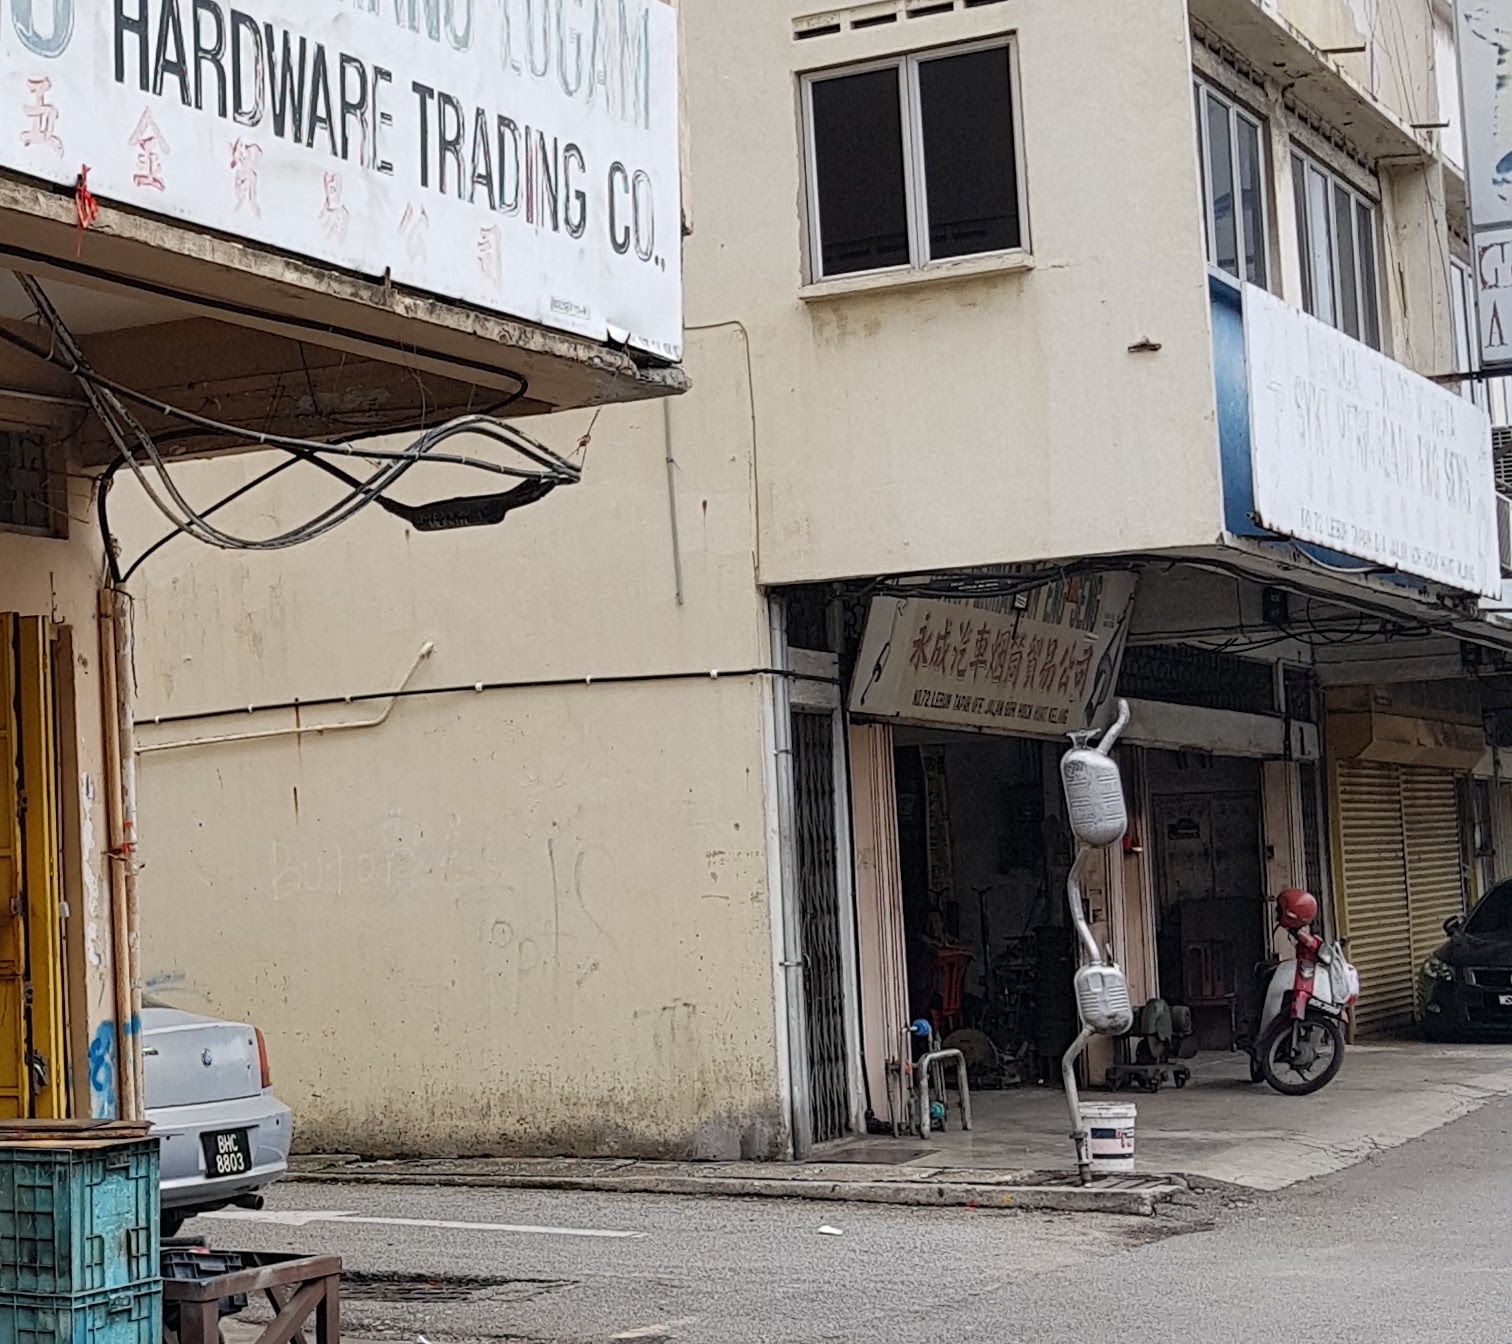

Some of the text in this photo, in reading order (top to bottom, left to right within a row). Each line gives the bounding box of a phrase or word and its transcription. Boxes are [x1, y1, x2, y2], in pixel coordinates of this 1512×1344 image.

[412, 81, 588, 239] TRADING
[216, 1133, 239, 1153] BHC
[215, 1153, 245, 1174] 8803
